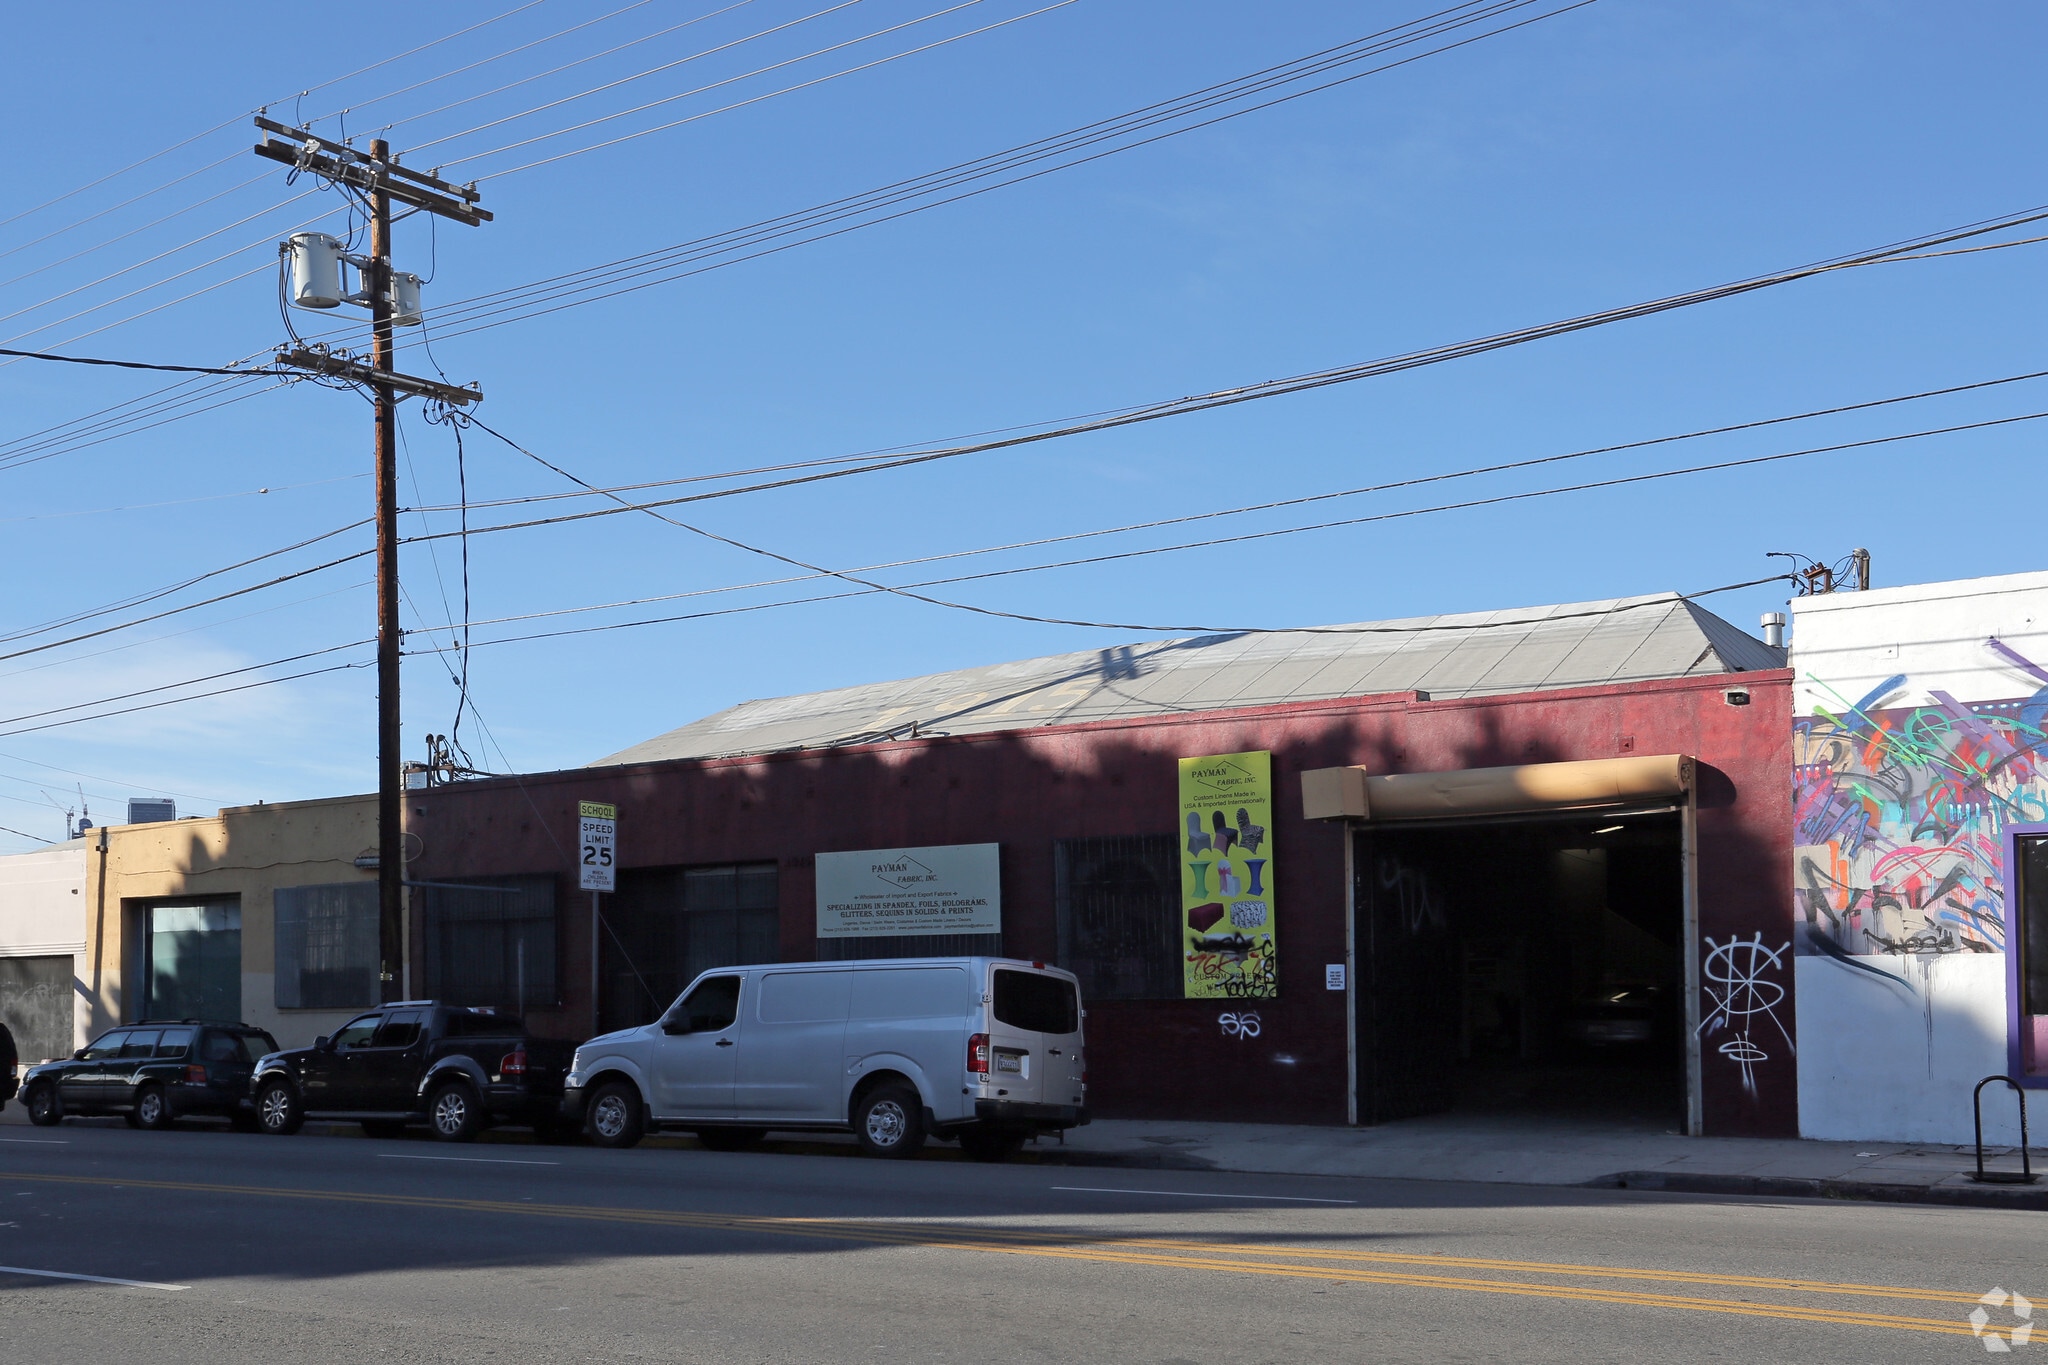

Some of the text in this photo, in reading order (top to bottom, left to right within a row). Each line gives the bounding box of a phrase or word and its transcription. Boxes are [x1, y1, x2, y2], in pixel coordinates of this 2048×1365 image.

[1191, 768, 1227, 778] PAYMAN
[1217, 778, 1243, 786] FABRIC,
[1203, 800, 1226, 808] Imported
[1228, 798, 1265, 806] Internationally
[581, 805, 613, 817] SCHOOL
[582, 823, 613, 834] SPEED
[585, 835, 610, 844] LIMIT
[583, 845, 612, 867] 25
[871, 863, 907, 873] PAYMAN
[897, 875, 924, 883] FABRIC,
[826, 903, 872, 911] SPECIALIZING
[919, 900, 940, 908] FOILS,
[942, 899, 988, 907] HOLOGRAMS,
[914, 908, 939, 916] SOLIDS
[948, 907, 974, 915] PRINTS
